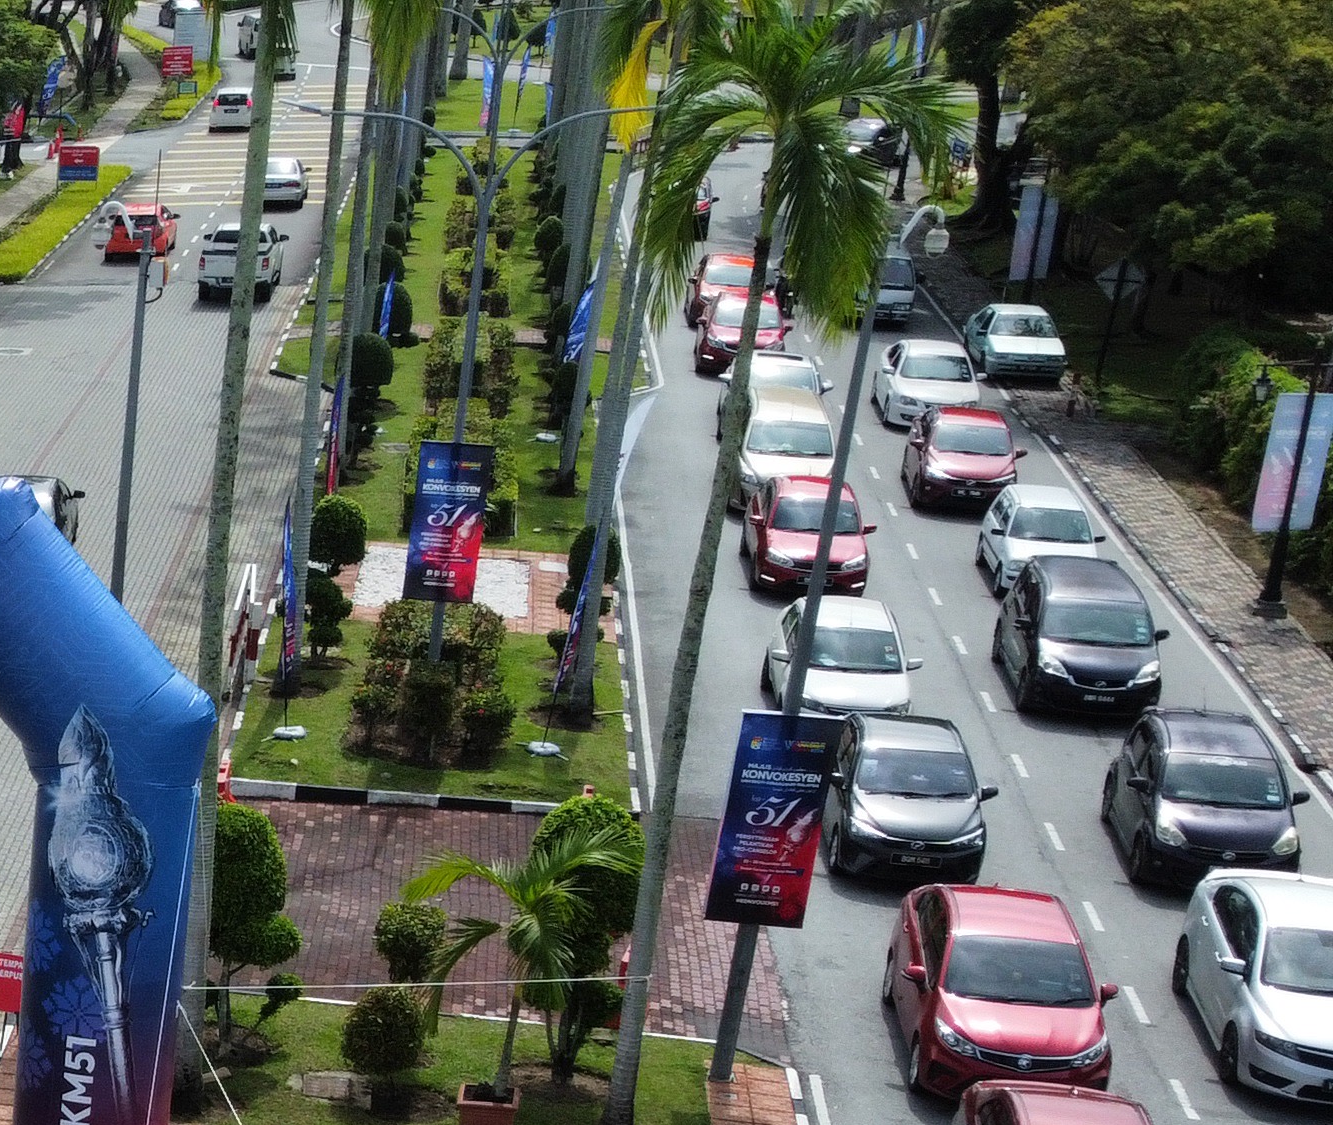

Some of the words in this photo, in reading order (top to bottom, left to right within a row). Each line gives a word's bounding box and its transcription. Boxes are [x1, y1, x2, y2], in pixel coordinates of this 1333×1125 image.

[426, 503, 468, 527] 51
[741, 769, 822, 783] KONVOKESYEN
[745, 796, 802, 827] 51
[0, 958, 23, 969] TEMPA
